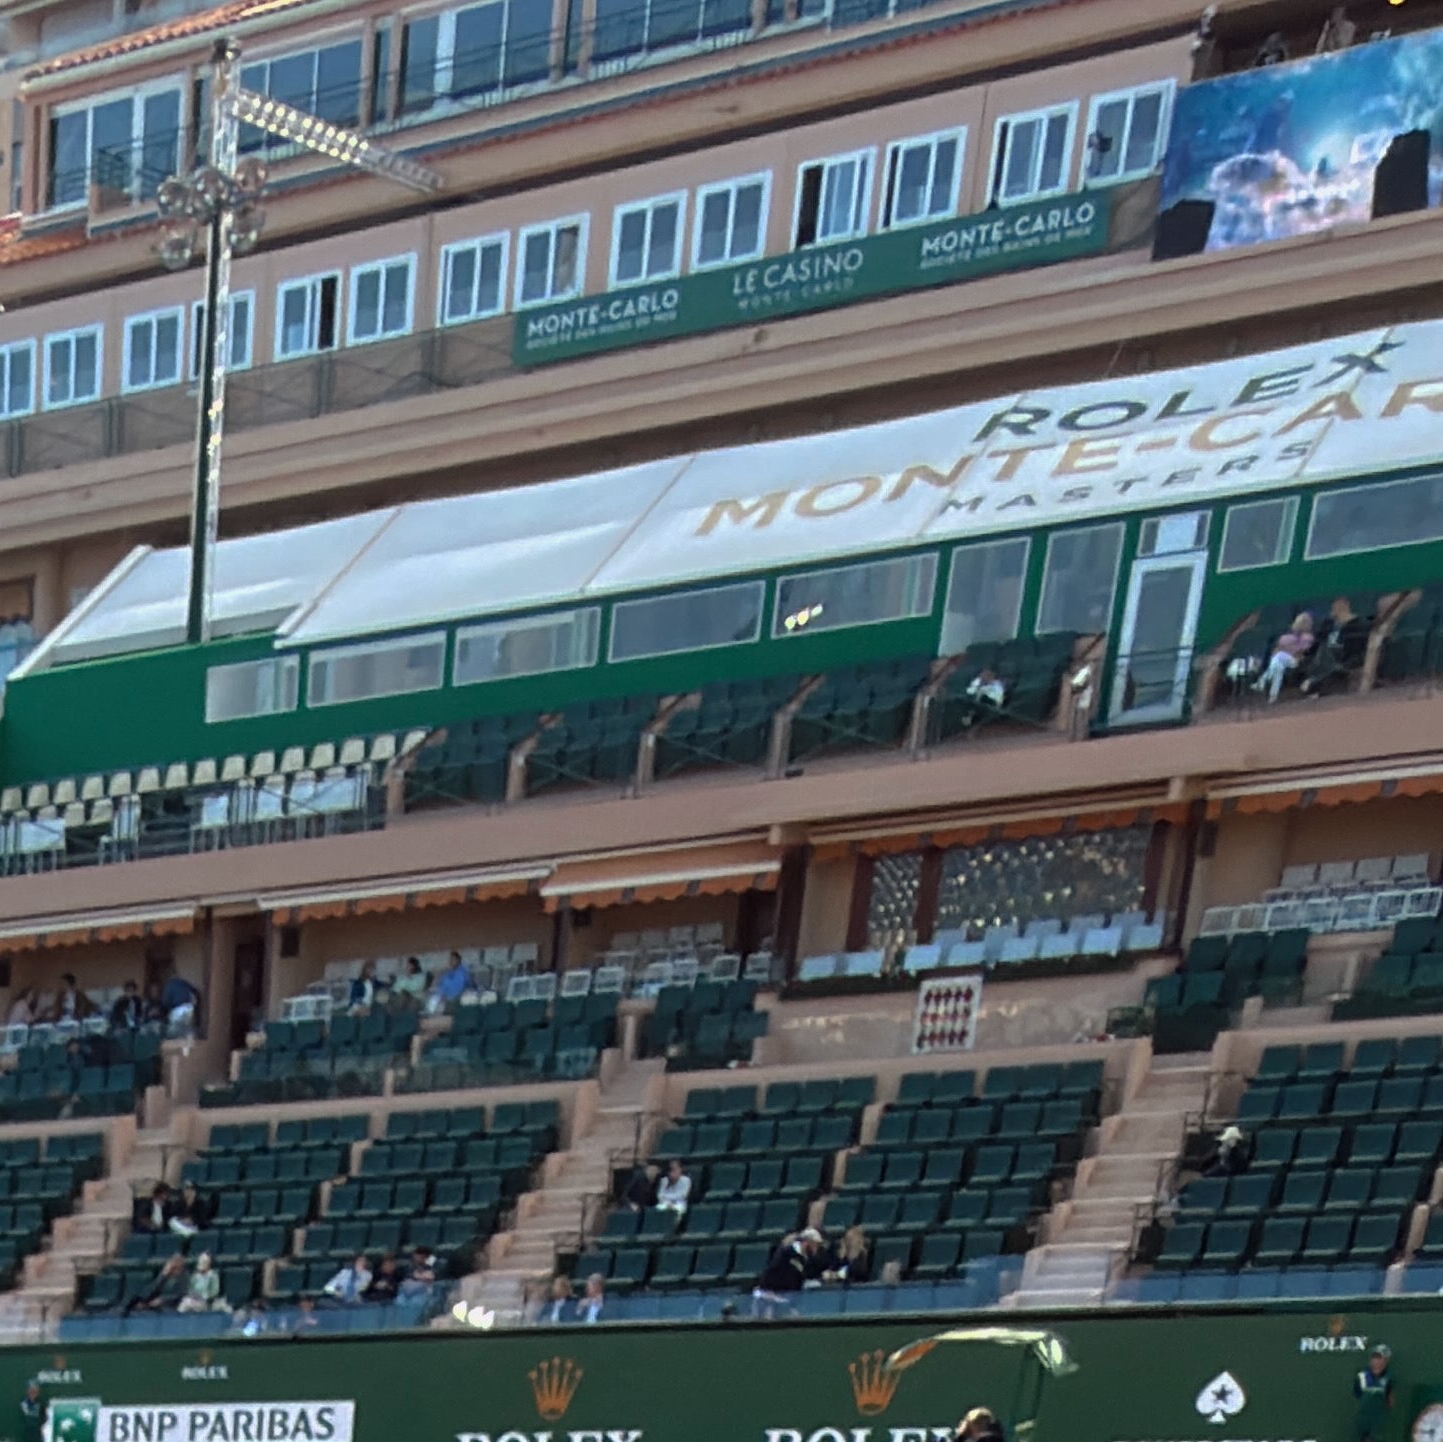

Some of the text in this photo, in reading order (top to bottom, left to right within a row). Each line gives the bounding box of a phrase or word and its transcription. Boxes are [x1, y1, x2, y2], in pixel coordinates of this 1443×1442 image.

[921, 202, 1095, 256] MONTE-CARLO
[733, 248, 864, 295] LE CASINO
[527, 288, 679, 337] MONTE-CARLO
[972, 341, 1406, 443] ROLEX
[933, 439, 1313, 517] MASTERS
[1300, 1336, 1367, 1352] ROLEX
[188, 1406, 335, 1442] PARIBAS
